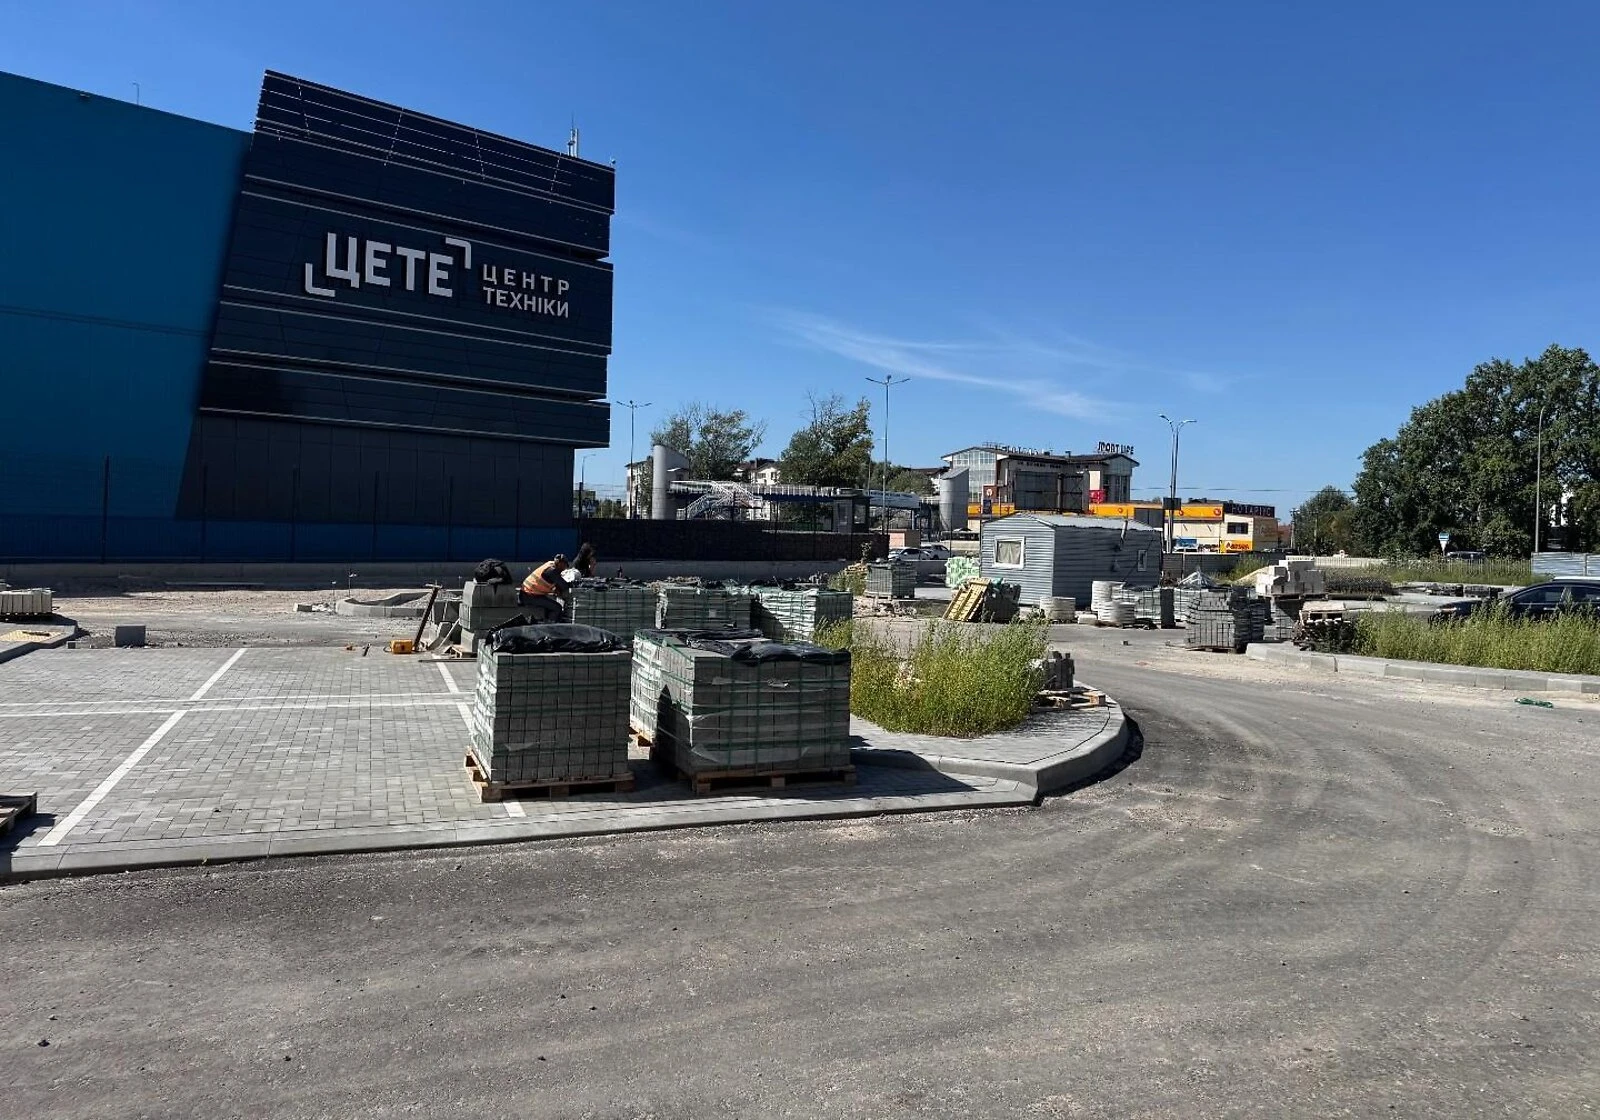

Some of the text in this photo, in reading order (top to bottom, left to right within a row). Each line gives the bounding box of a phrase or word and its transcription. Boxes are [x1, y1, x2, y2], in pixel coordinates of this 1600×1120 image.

[326, 232, 453, 298] ЦЕТЕ
[482, 264, 570, 295] ЦЕНТР
[483, 286, 570, 318] ТЕХНІКИ
